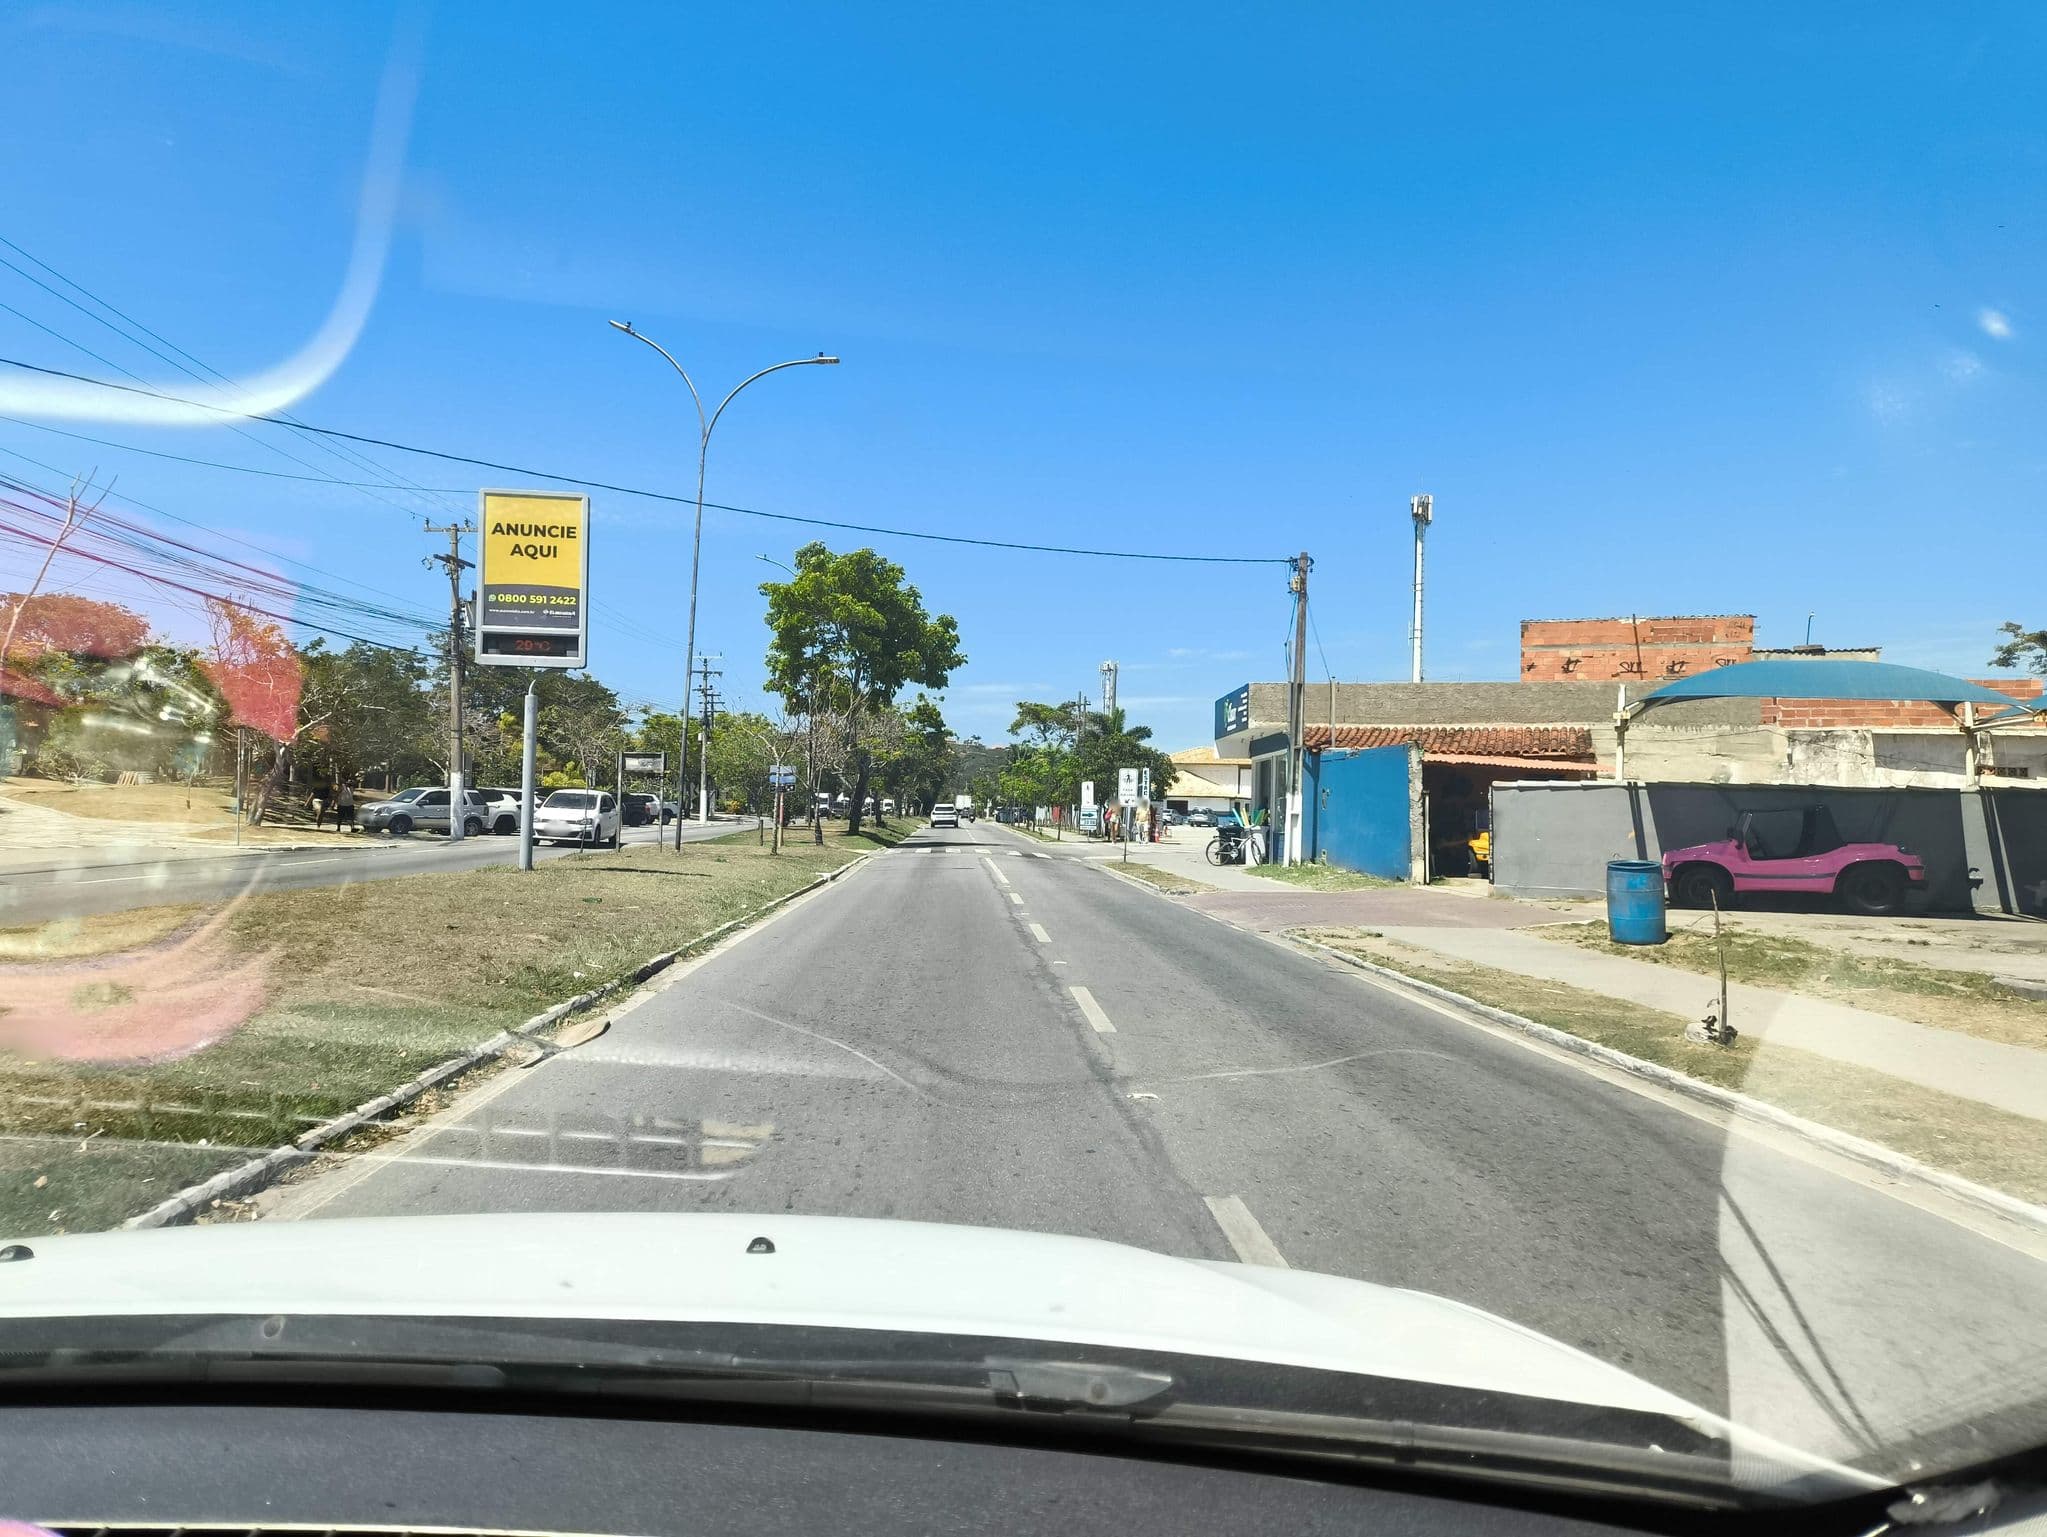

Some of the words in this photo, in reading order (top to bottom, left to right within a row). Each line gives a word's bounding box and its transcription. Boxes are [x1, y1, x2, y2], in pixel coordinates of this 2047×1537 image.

[491, 522, 577, 539] ANUNCIE
[510, 543, 558, 560] AQUI
[498, 593, 527, 603] 0800
[529, 594, 547, 604] 591
[549, 595, 577, 605] 2422
